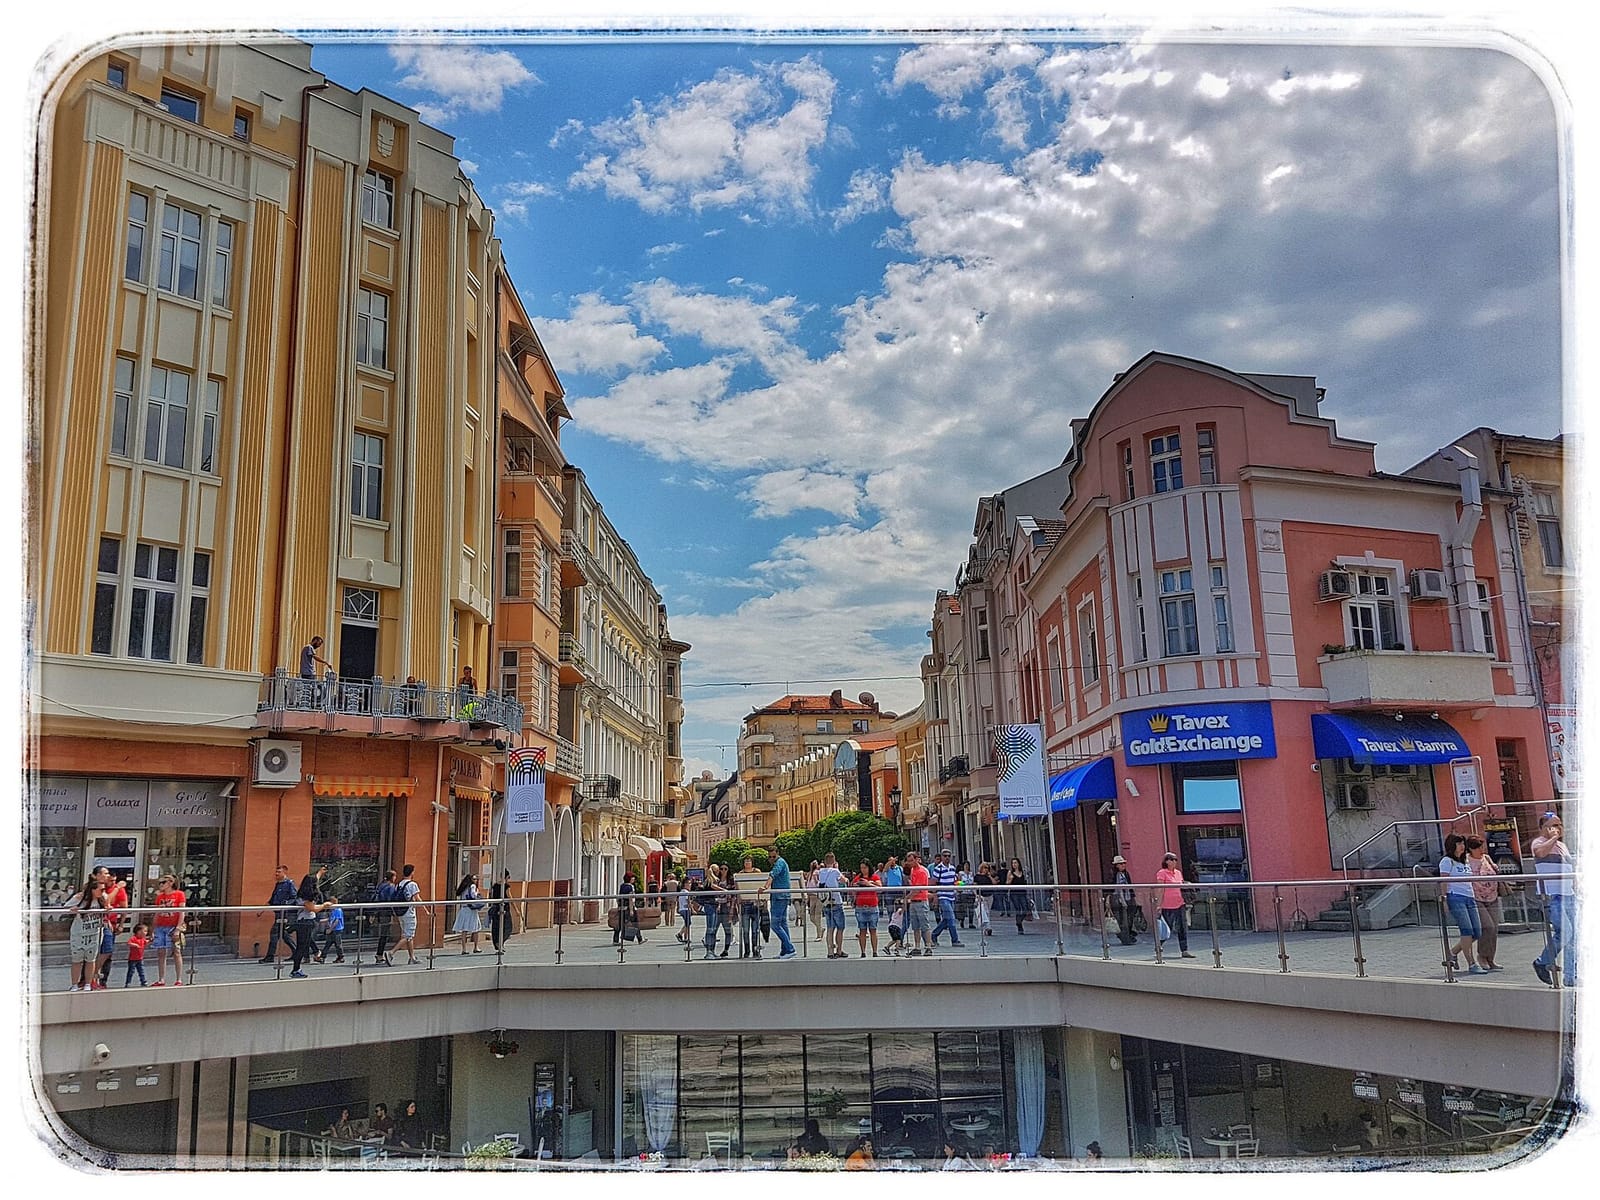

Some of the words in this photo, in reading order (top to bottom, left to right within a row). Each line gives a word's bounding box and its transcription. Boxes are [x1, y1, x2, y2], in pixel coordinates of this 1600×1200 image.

[1172, 714, 1230, 731] Tavex
[1357, 738, 1401, 752] Tavex
[97, 796, 141, 809] Сомаха
[175, 791, 209, 803] Gold
